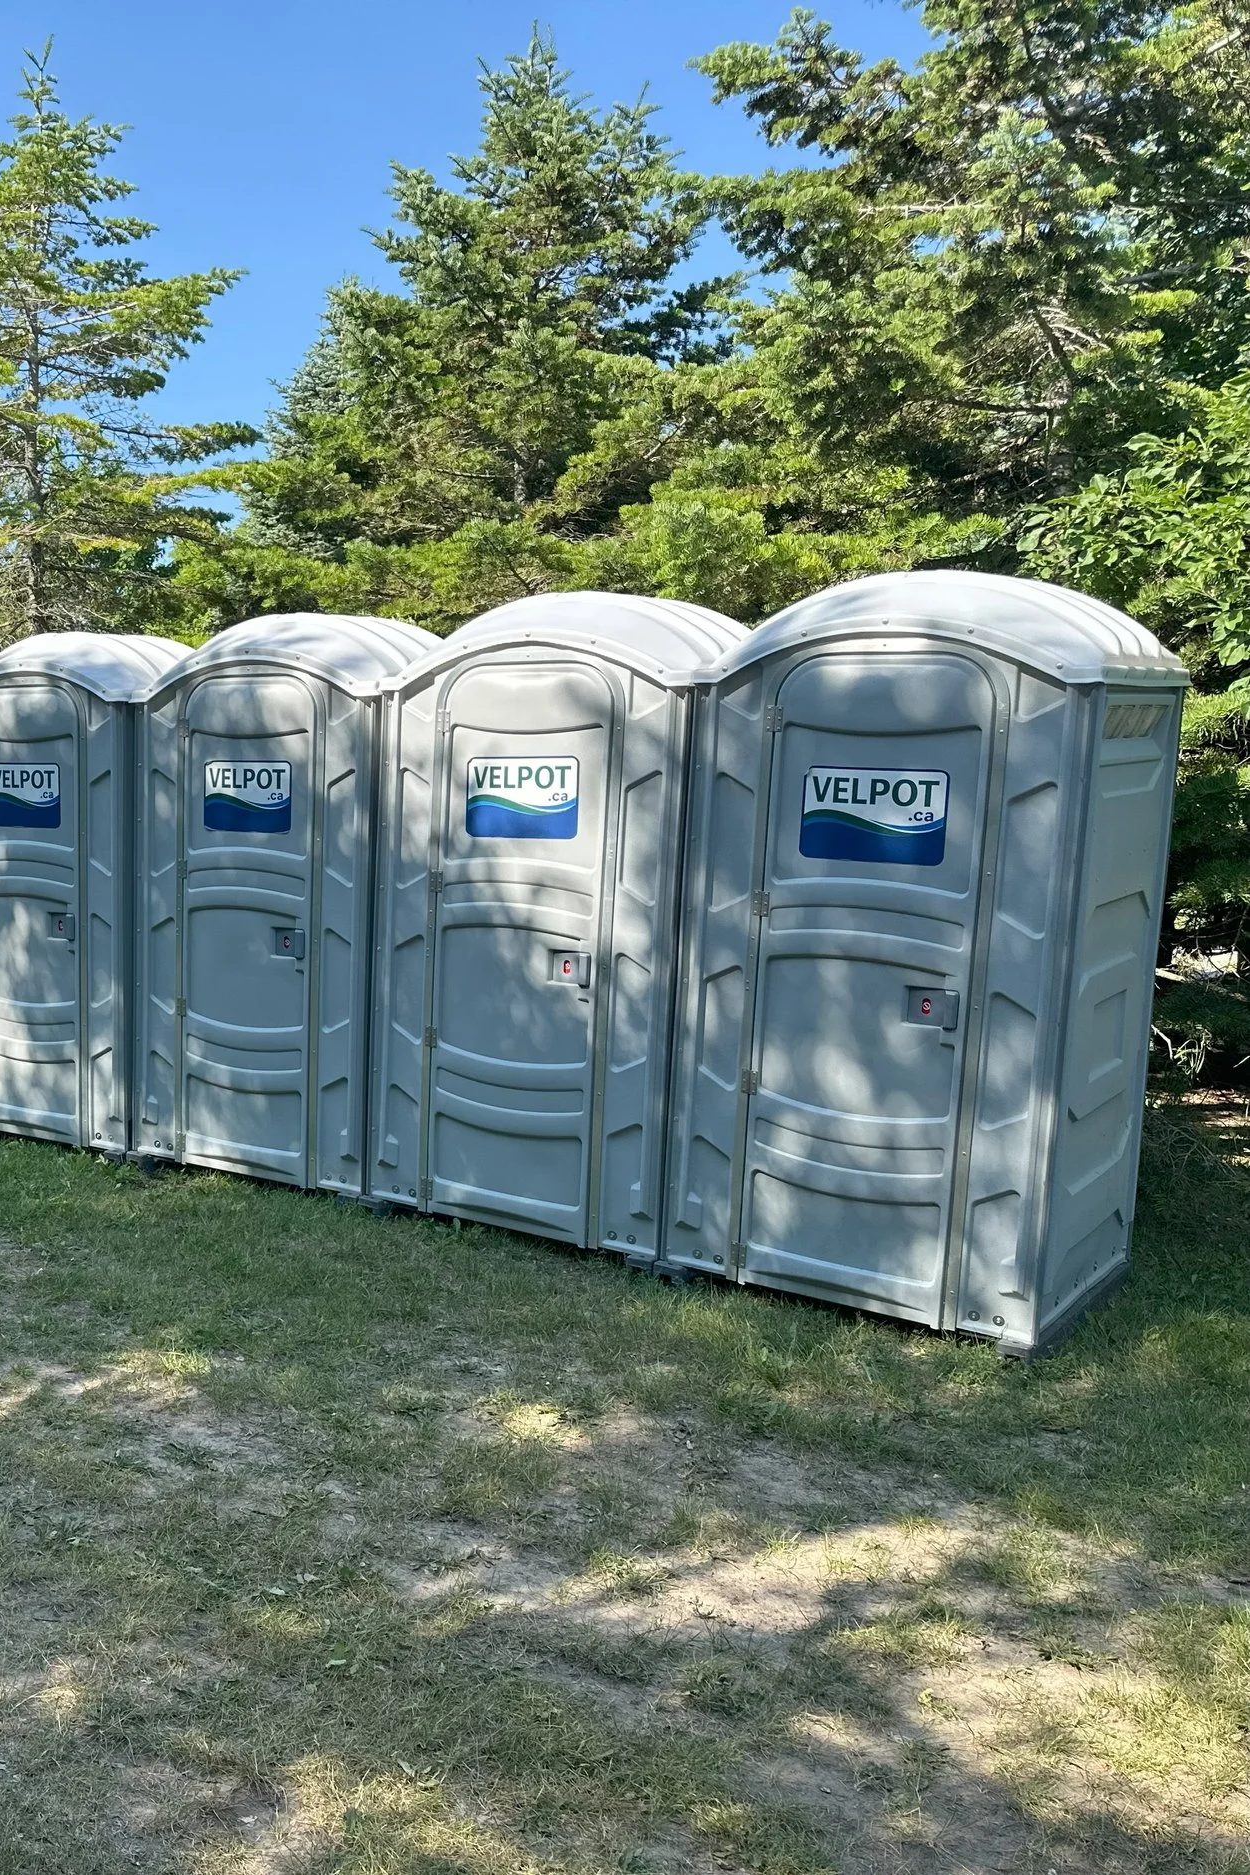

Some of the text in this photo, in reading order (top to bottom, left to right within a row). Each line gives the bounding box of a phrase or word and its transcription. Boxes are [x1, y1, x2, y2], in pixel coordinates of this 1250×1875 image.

[209, 766, 286, 790] VELPOT
[473, 765, 572, 790] VELPOT
[40, 790, 54, 799] .ca
[267, 791, 283, 801] .ca
[547, 791, 568, 802] .ca
[812, 776, 940, 808] VELPOT
[908, 811, 934, 822] .ca
